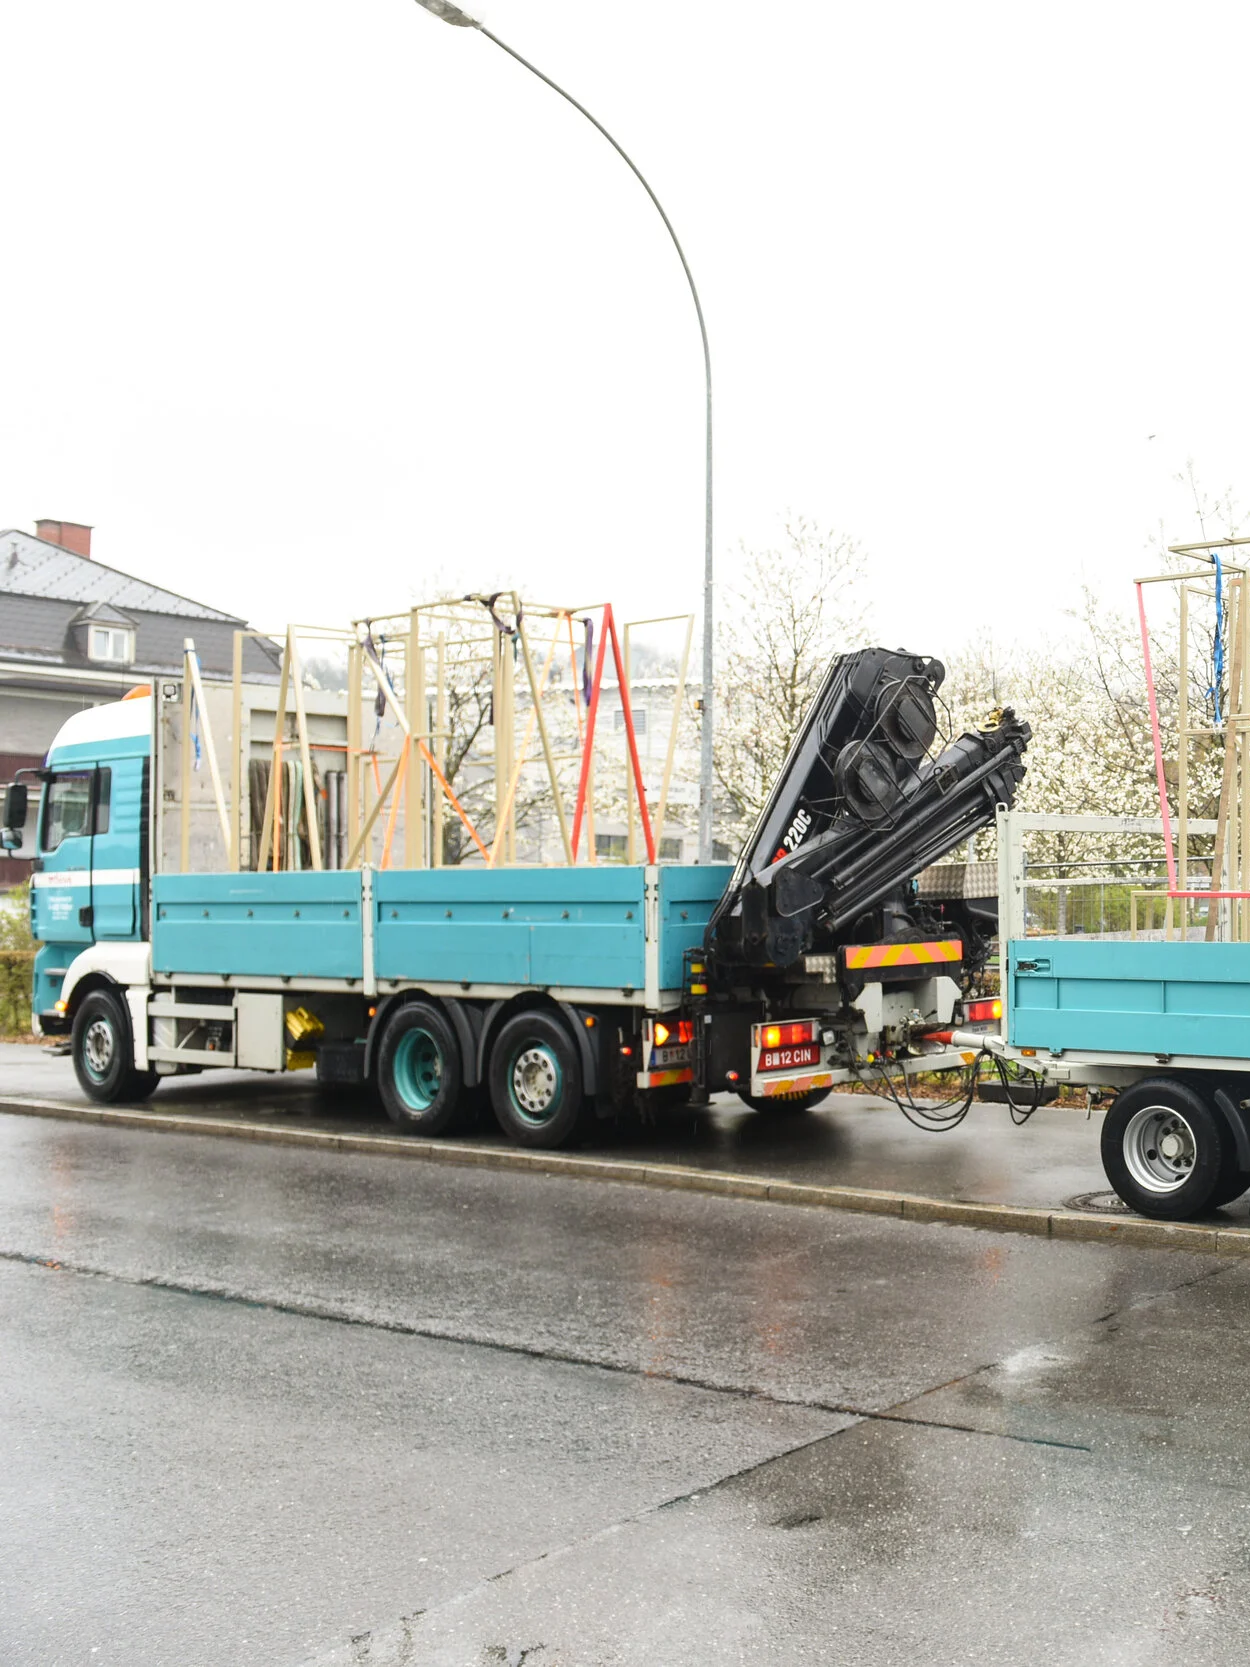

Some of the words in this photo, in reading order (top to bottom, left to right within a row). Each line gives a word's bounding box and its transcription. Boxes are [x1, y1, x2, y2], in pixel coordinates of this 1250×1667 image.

[783, 808, 812, 852] 220C
[765, 1053, 773, 1067] B
[780, 1051, 792, 1065] 12
[793, 1049, 812, 1063] CIN
